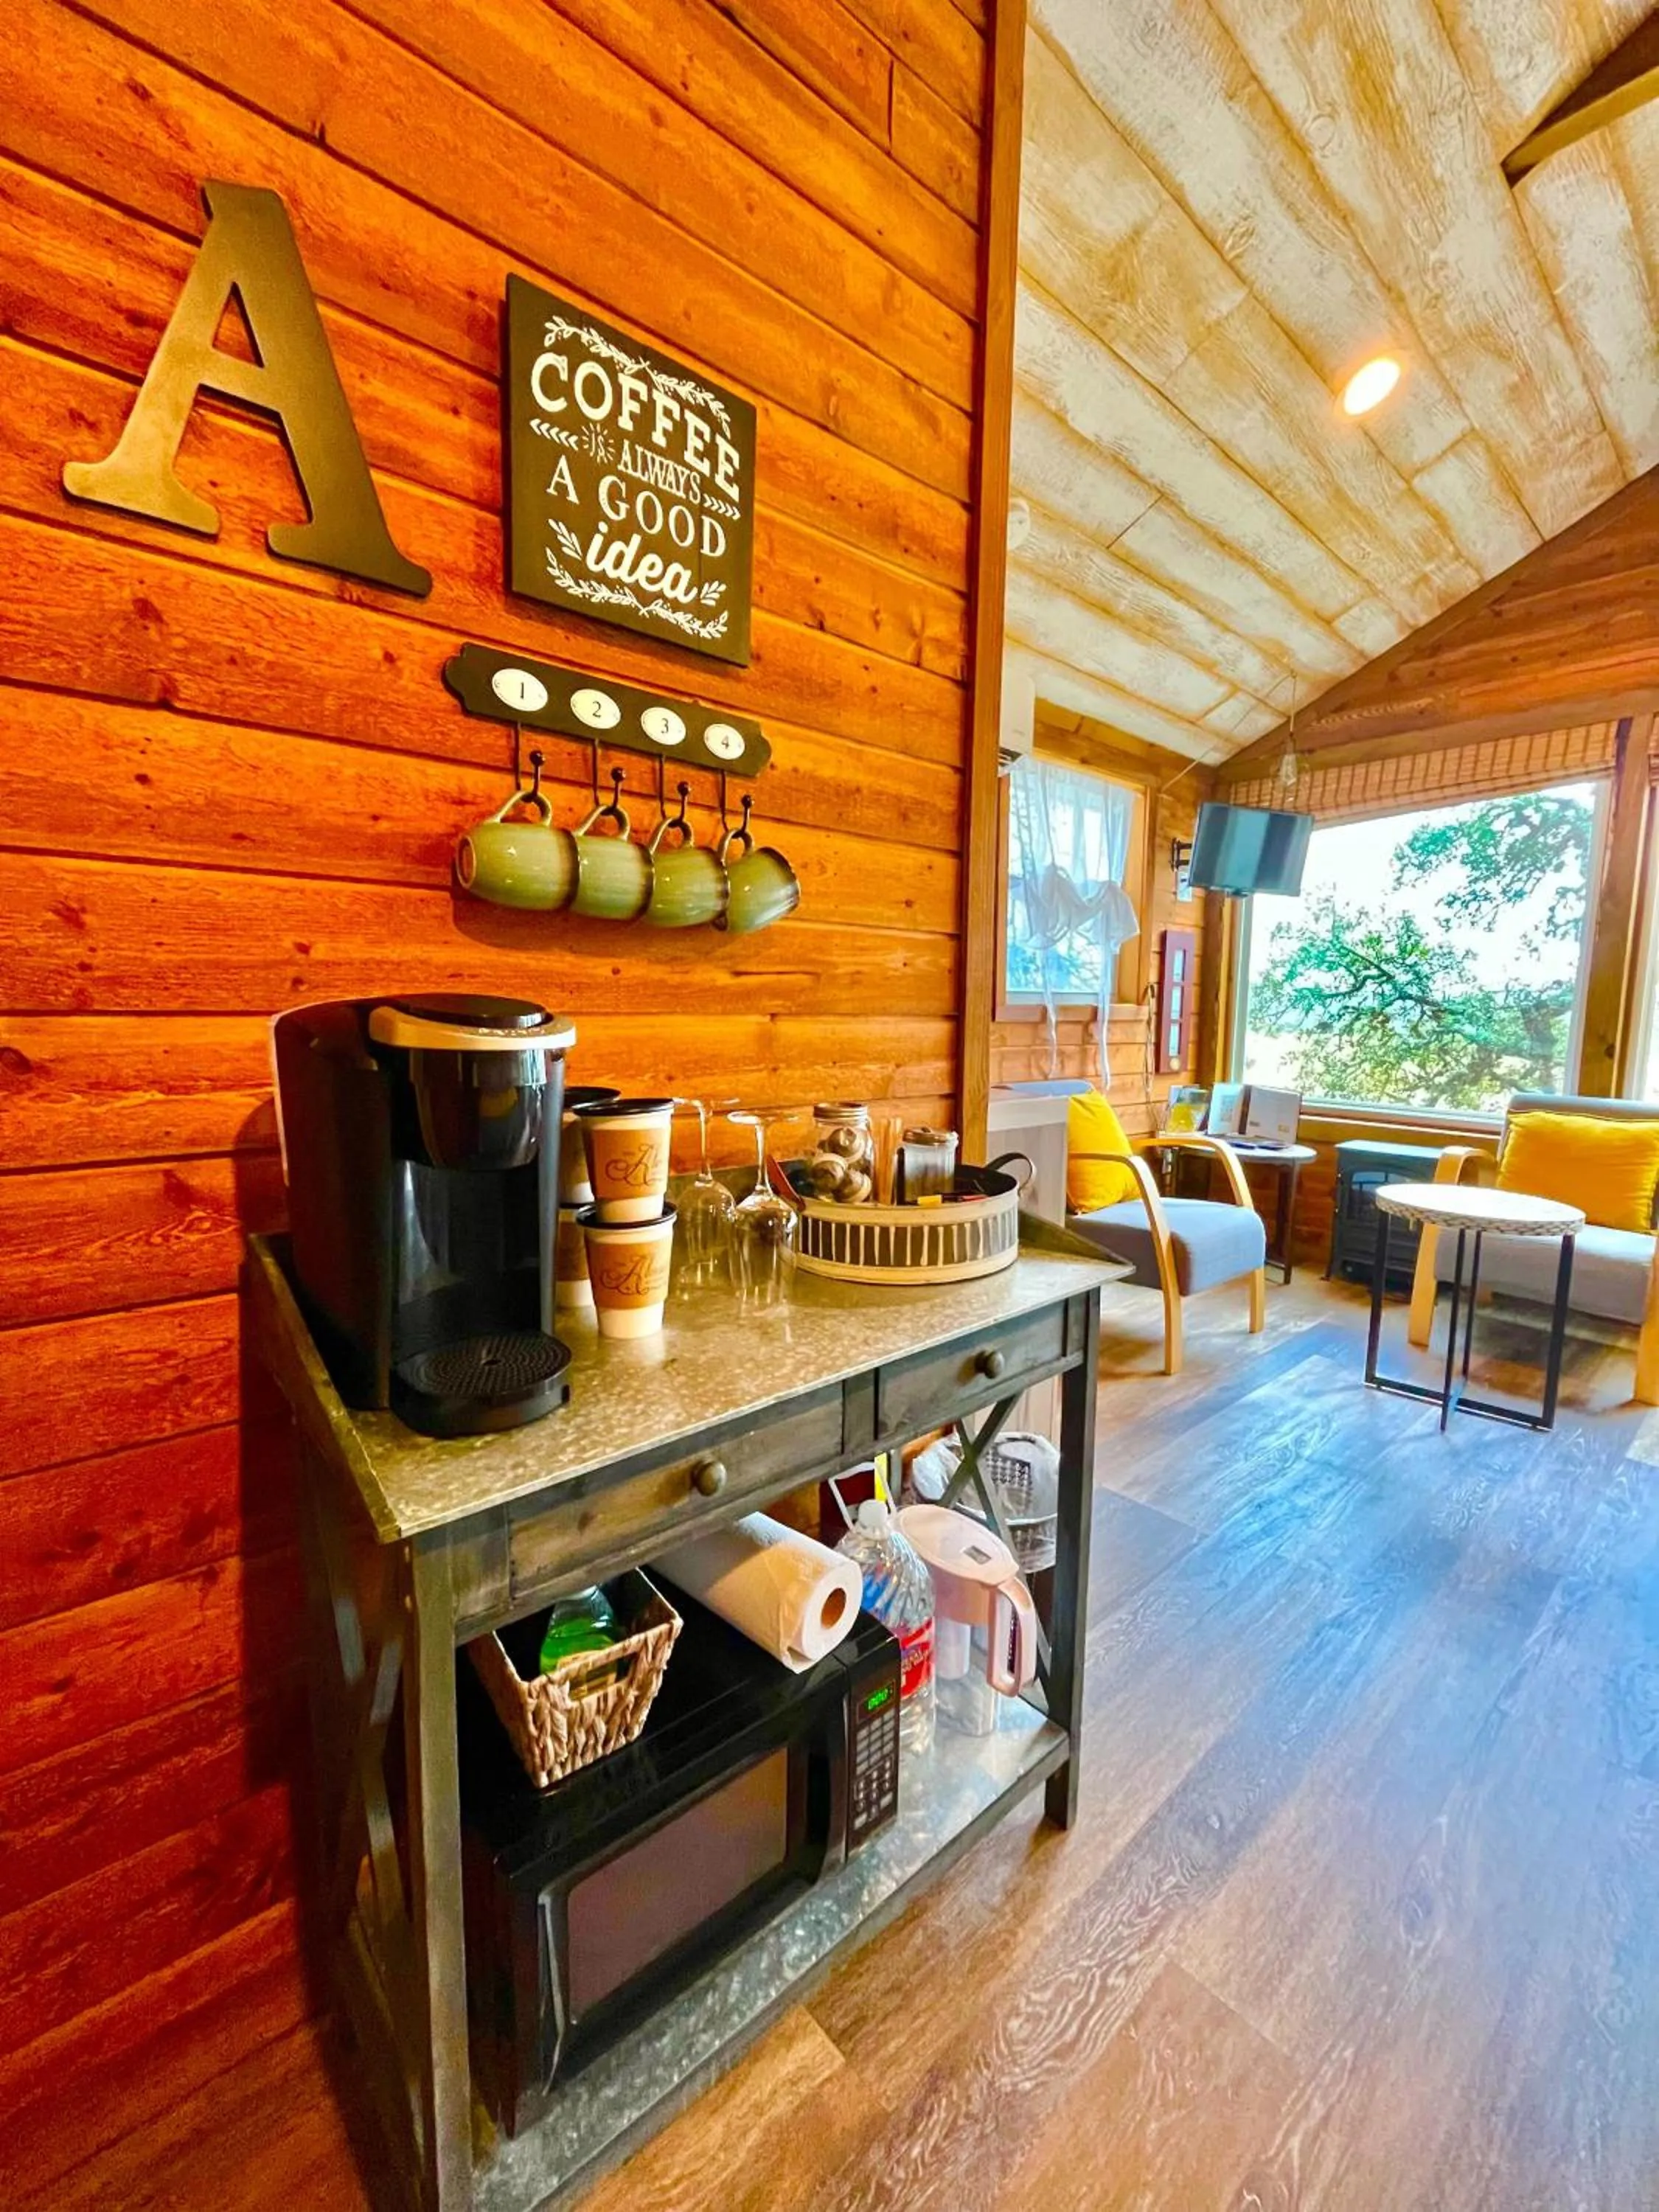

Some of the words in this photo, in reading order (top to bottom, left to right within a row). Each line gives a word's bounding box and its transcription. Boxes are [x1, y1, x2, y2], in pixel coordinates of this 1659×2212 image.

[63, 179, 432, 598] A
[531, 352, 739, 503] COFFEE
[546, 455, 579, 504] A
[598, 475, 726, 557] GOOD
[617, 439, 701, 504] ALWAYS
[586, 522, 698, 603] idea
[519, 681, 526, 700] 1
[592, 701, 602, 718] 2
[661, 718, 669, 734] 3
[720, 735, 729, 749] 4
